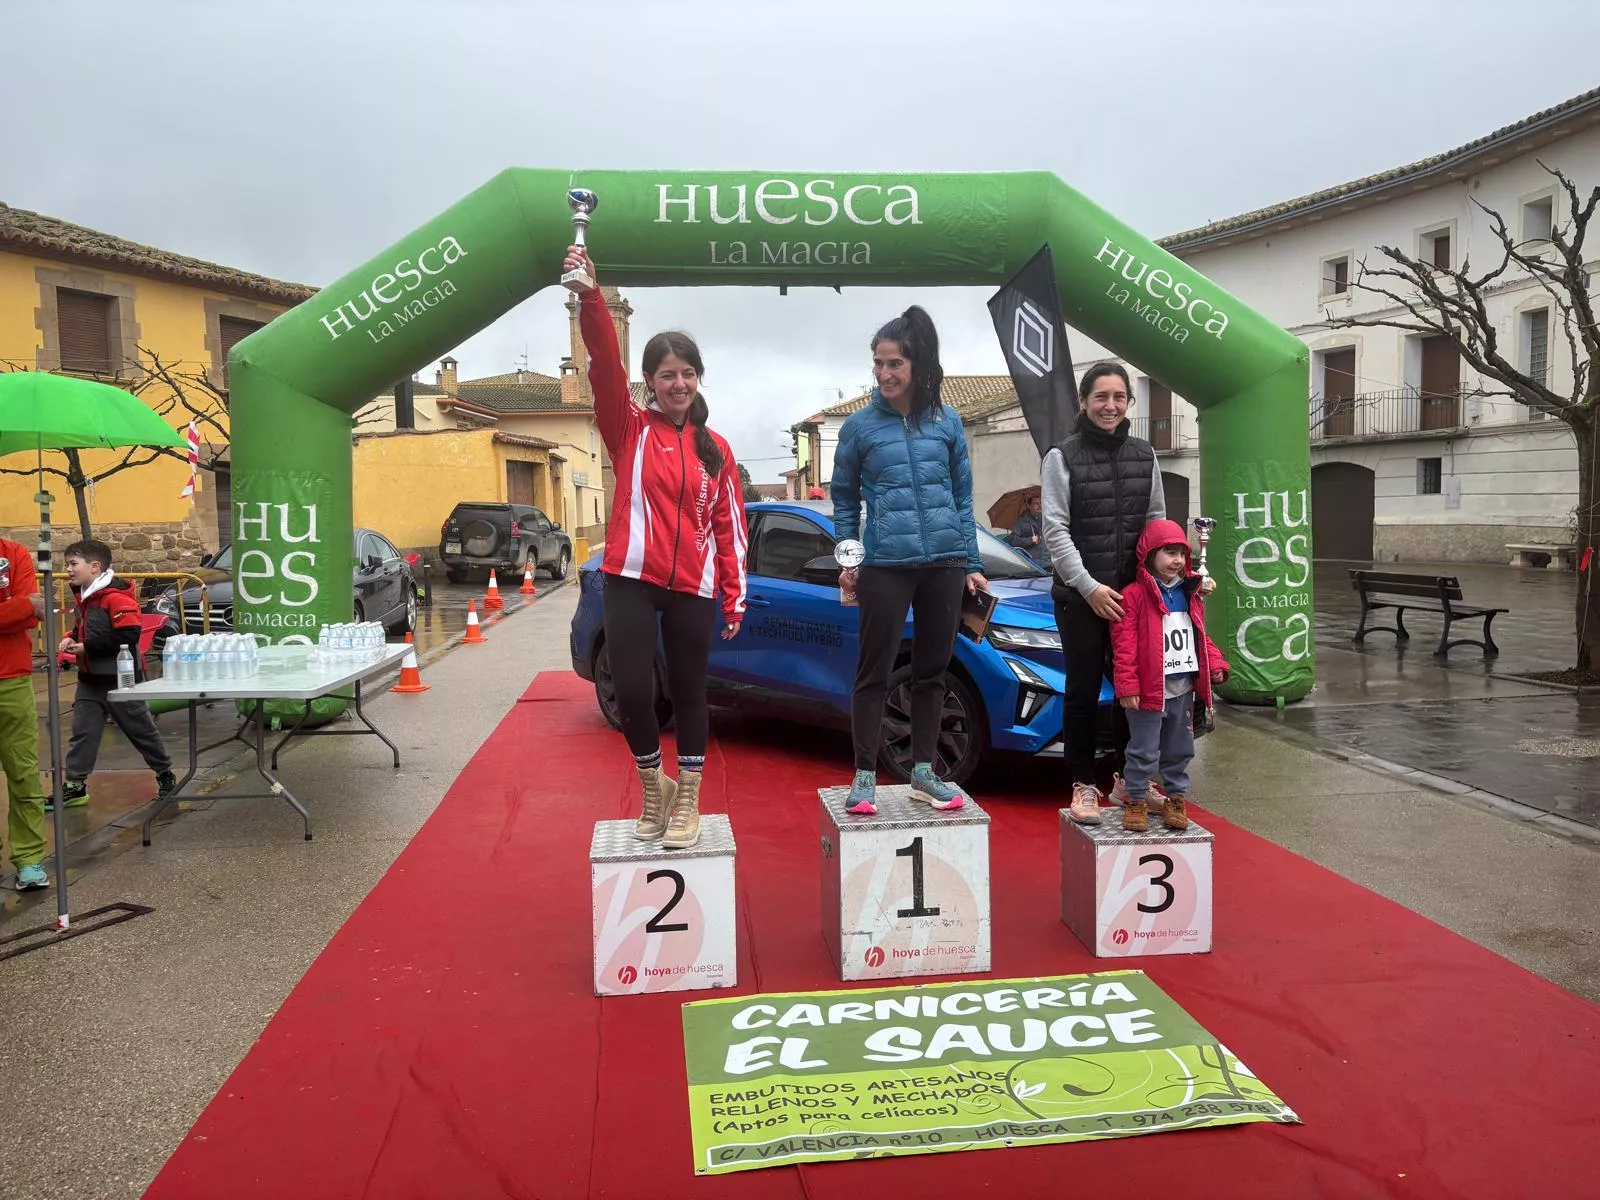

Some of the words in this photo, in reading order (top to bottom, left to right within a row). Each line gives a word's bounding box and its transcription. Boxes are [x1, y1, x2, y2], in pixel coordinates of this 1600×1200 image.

[653, 178, 924, 226] Huesca
[319, 235, 469, 341] Huesca
[1093, 236, 1229, 340] Huesca
[236, 502, 321, 543] Hu
[1233, 488, 1309, 529] Hu
[238, 549, 319, 607] es
[1234, 534, 1310, 589] es
[807, 632, 843, 648] HYBRID
[646, 869, 688, 933] 2
[895, 837, 940, 918] 1
[1137, 853, 1175, 913] 3
[893, 948, 921, 959] hoya
[922, 946, 936, 956] de
[937, 944, 976, 955] huesca
[1134, 930, 1155, 939] hoya
[1157, 929, 1167, 937] de
[1168, 928, 1198, 937] huesca
[644, 967, 671, 977] hoya
[673, 965, 686, 975] de
[687, 962, 724, 973] huesca
[731, 981, 1139, 1030] CARNICERÍA
[723, 1036, 829, 1075] EL
[862, 1008, 1164, 1063] SAUCE
[709, 1083, 856, 1104] EMBUTIDOS
[711, 1097, 837, 1117] RELLENOS
[845, 1095, 860, 1106] Y
[872, 1083, 1005, 1105] MECHADOS
[713, 1113, 789, 1134] (Aptos
[799, 1112, 851, 1123] para
[861, 1103, 958, 1120] celíacos)
[720, 1147, 745, 1161] C/
[756, 1135, 880, 1158] VALENCIA
[975, 1123, 1070, 1140] HUESCA
[1132, 1111, 1174, 1126] 974
[1182, 1103, 1221, 1117] 238
[1228, 1102, 1271, 1114] 578
